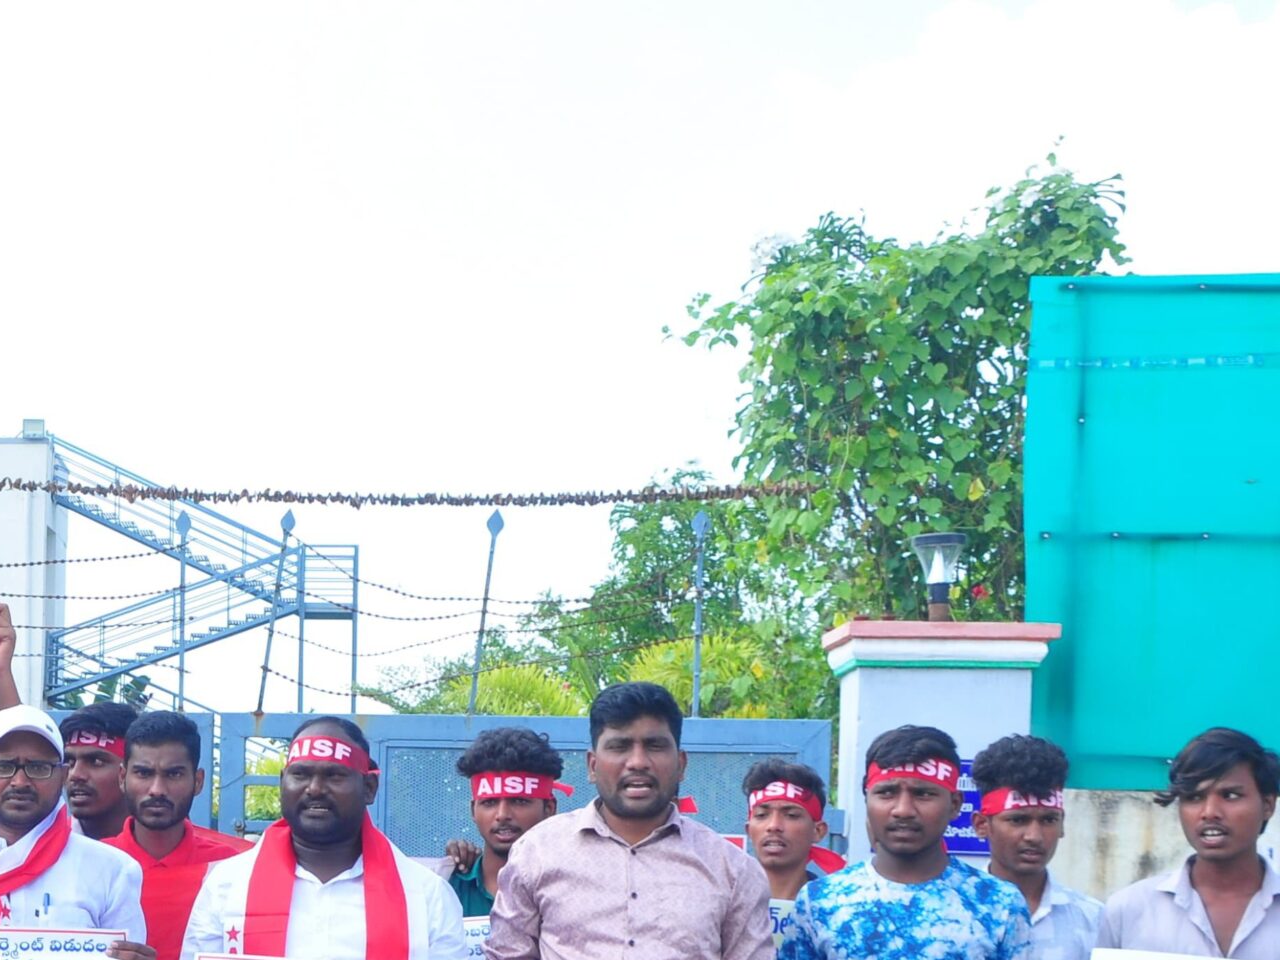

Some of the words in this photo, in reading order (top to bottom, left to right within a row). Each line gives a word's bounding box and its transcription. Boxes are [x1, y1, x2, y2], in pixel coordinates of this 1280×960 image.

[71, 730, 115, 747] ISF
[287, 734, 352, 762] AISF
[476, 776, 540, 796] AISF
[49, 938, 107, 952] విడుదల
